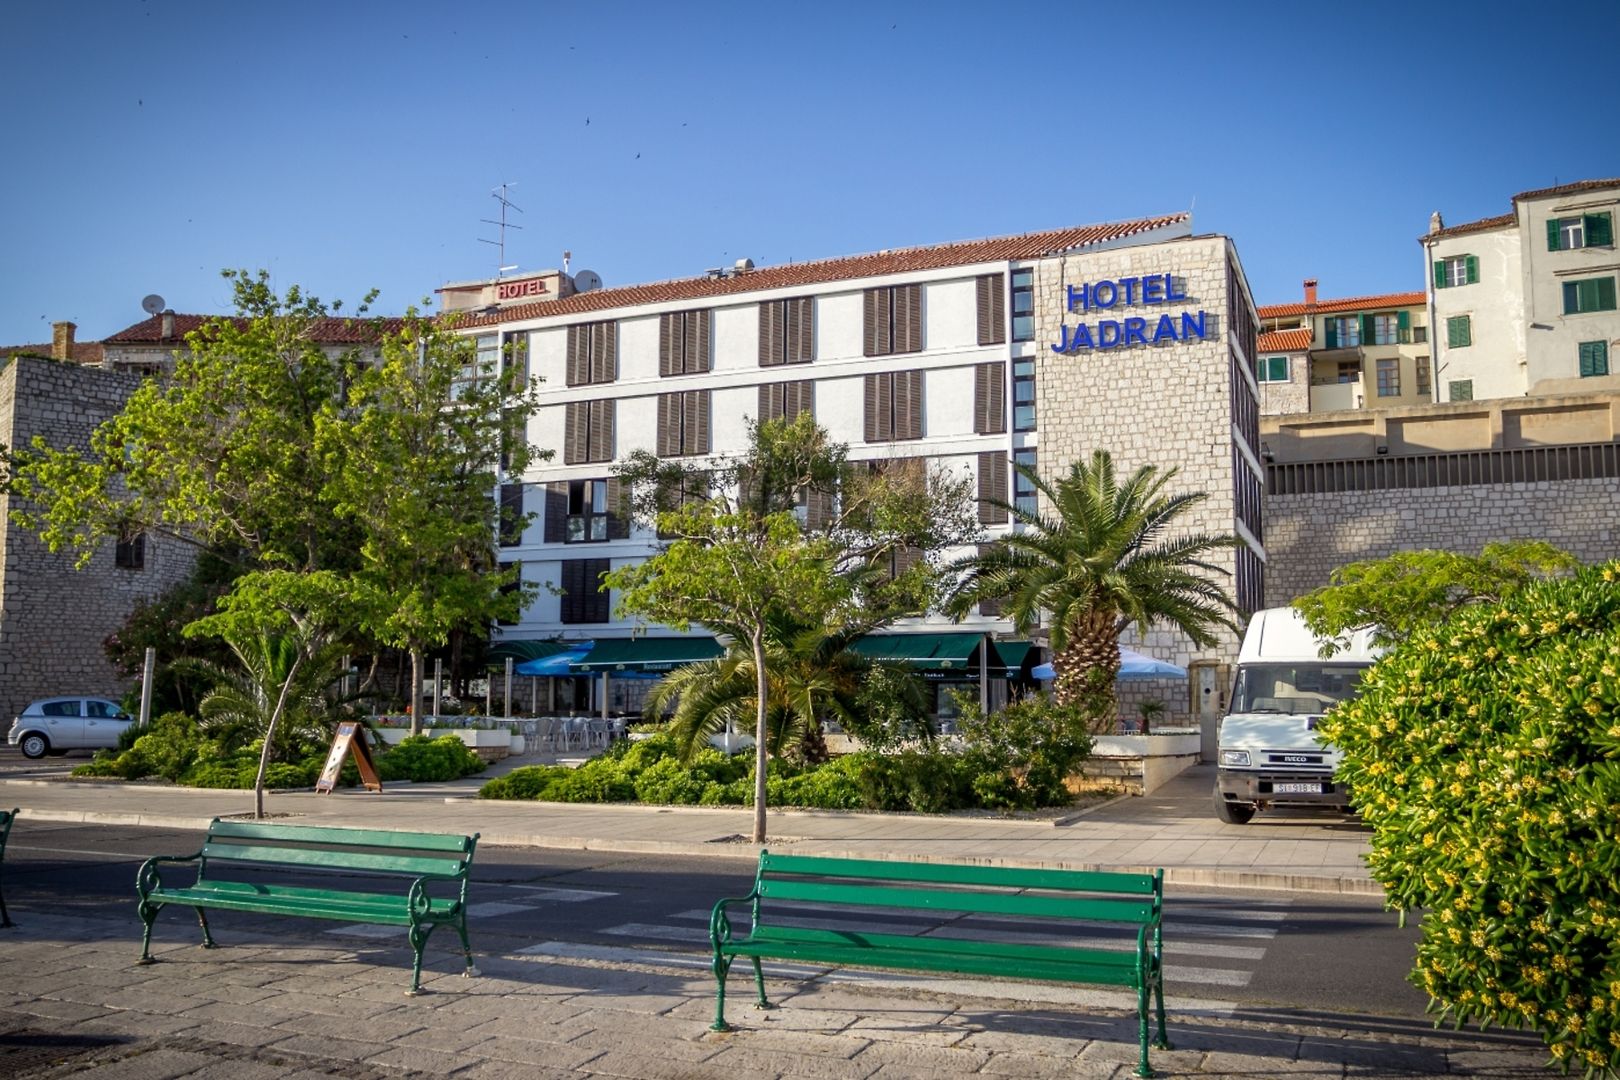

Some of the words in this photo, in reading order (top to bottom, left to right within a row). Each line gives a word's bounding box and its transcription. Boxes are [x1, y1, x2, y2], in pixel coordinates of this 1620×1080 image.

[498, 279, 545, 299] HOTEL
[1067, 273, 1185, 312] HOTEL
[1051, 310, 1205, 353] JADRAN
